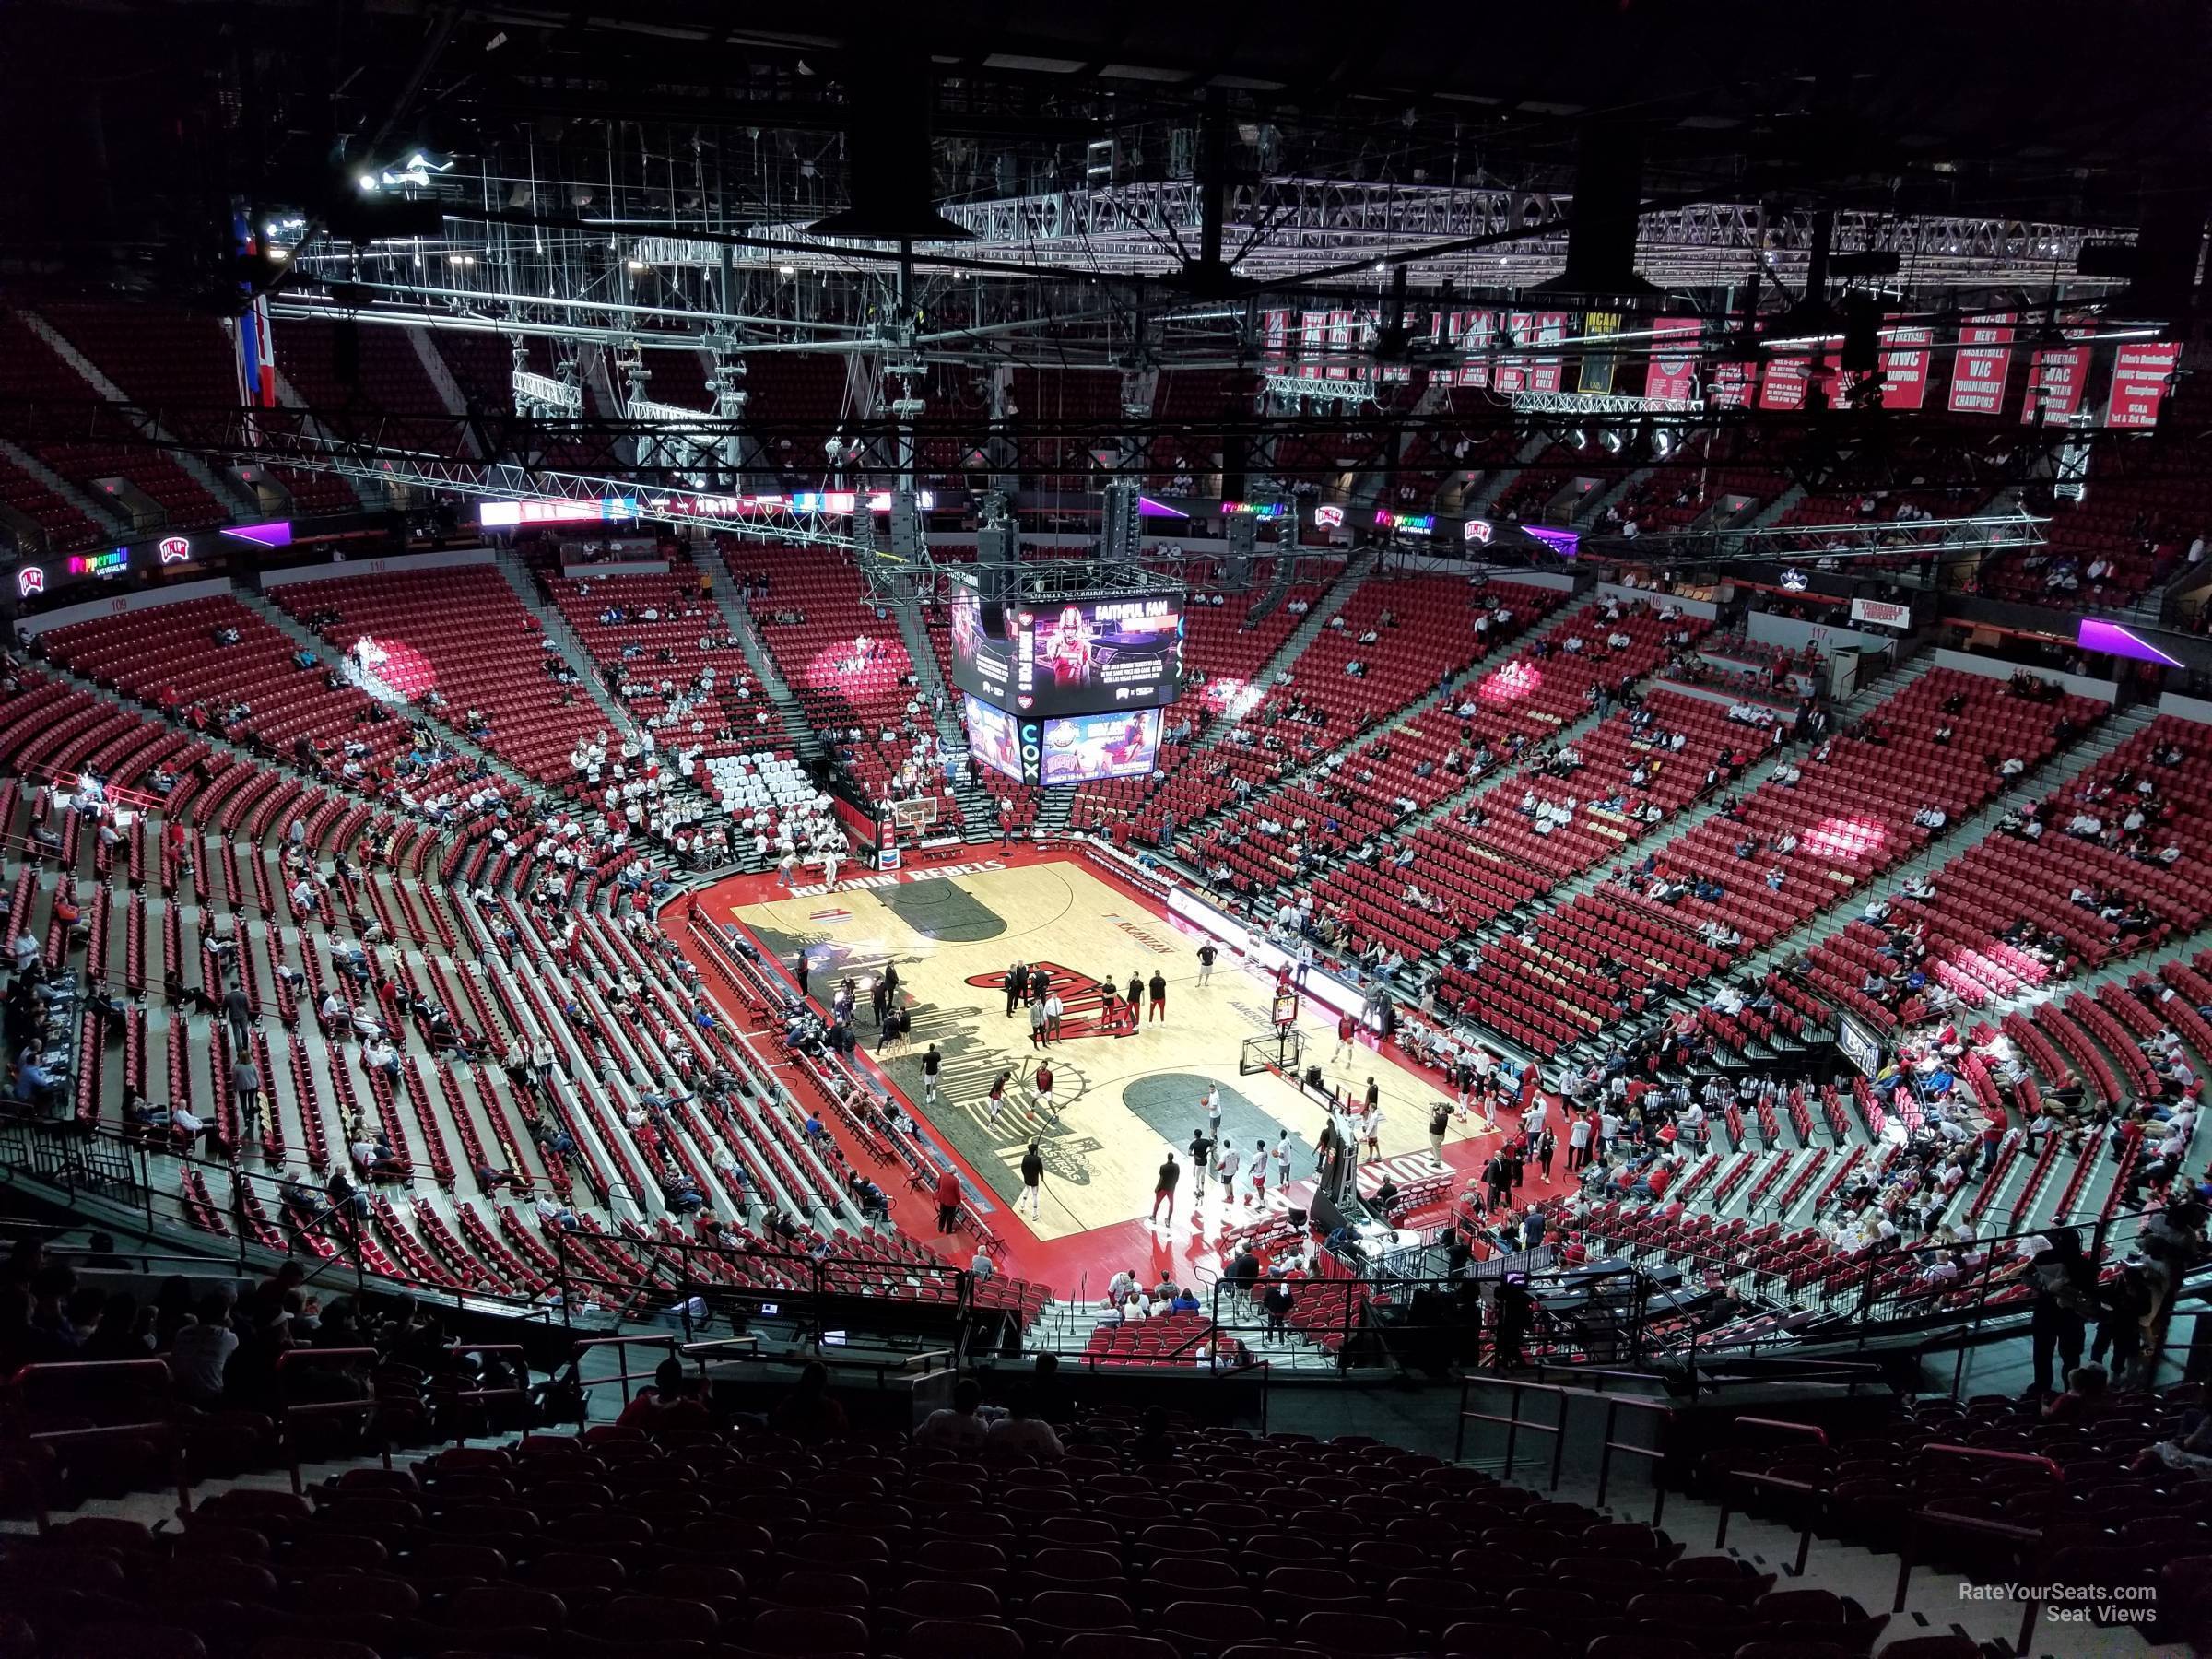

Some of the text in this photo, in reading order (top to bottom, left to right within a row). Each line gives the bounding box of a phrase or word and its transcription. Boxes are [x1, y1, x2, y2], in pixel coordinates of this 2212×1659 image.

[1589, 313, 1617, 326] NCAA
[1975, 331, 1997, 342] MEN'S
[1887, 371, 1919, 381] HAMPIONS
[1970, 360, 1991, 377] WAC
[71, 547, 127, 574] Peppermill
[112, 599, 126, 610] 109
[1096, 600, 1168, 620] FAITHFUL FAN
[1812, 627, 1828, 640] 117
[1022, 724, 1040, 779] COX
[789, 859, 1007, 898] RUNNIN' REBELS
[1038, 1143, 1081, 1181] LAS VEGAS
